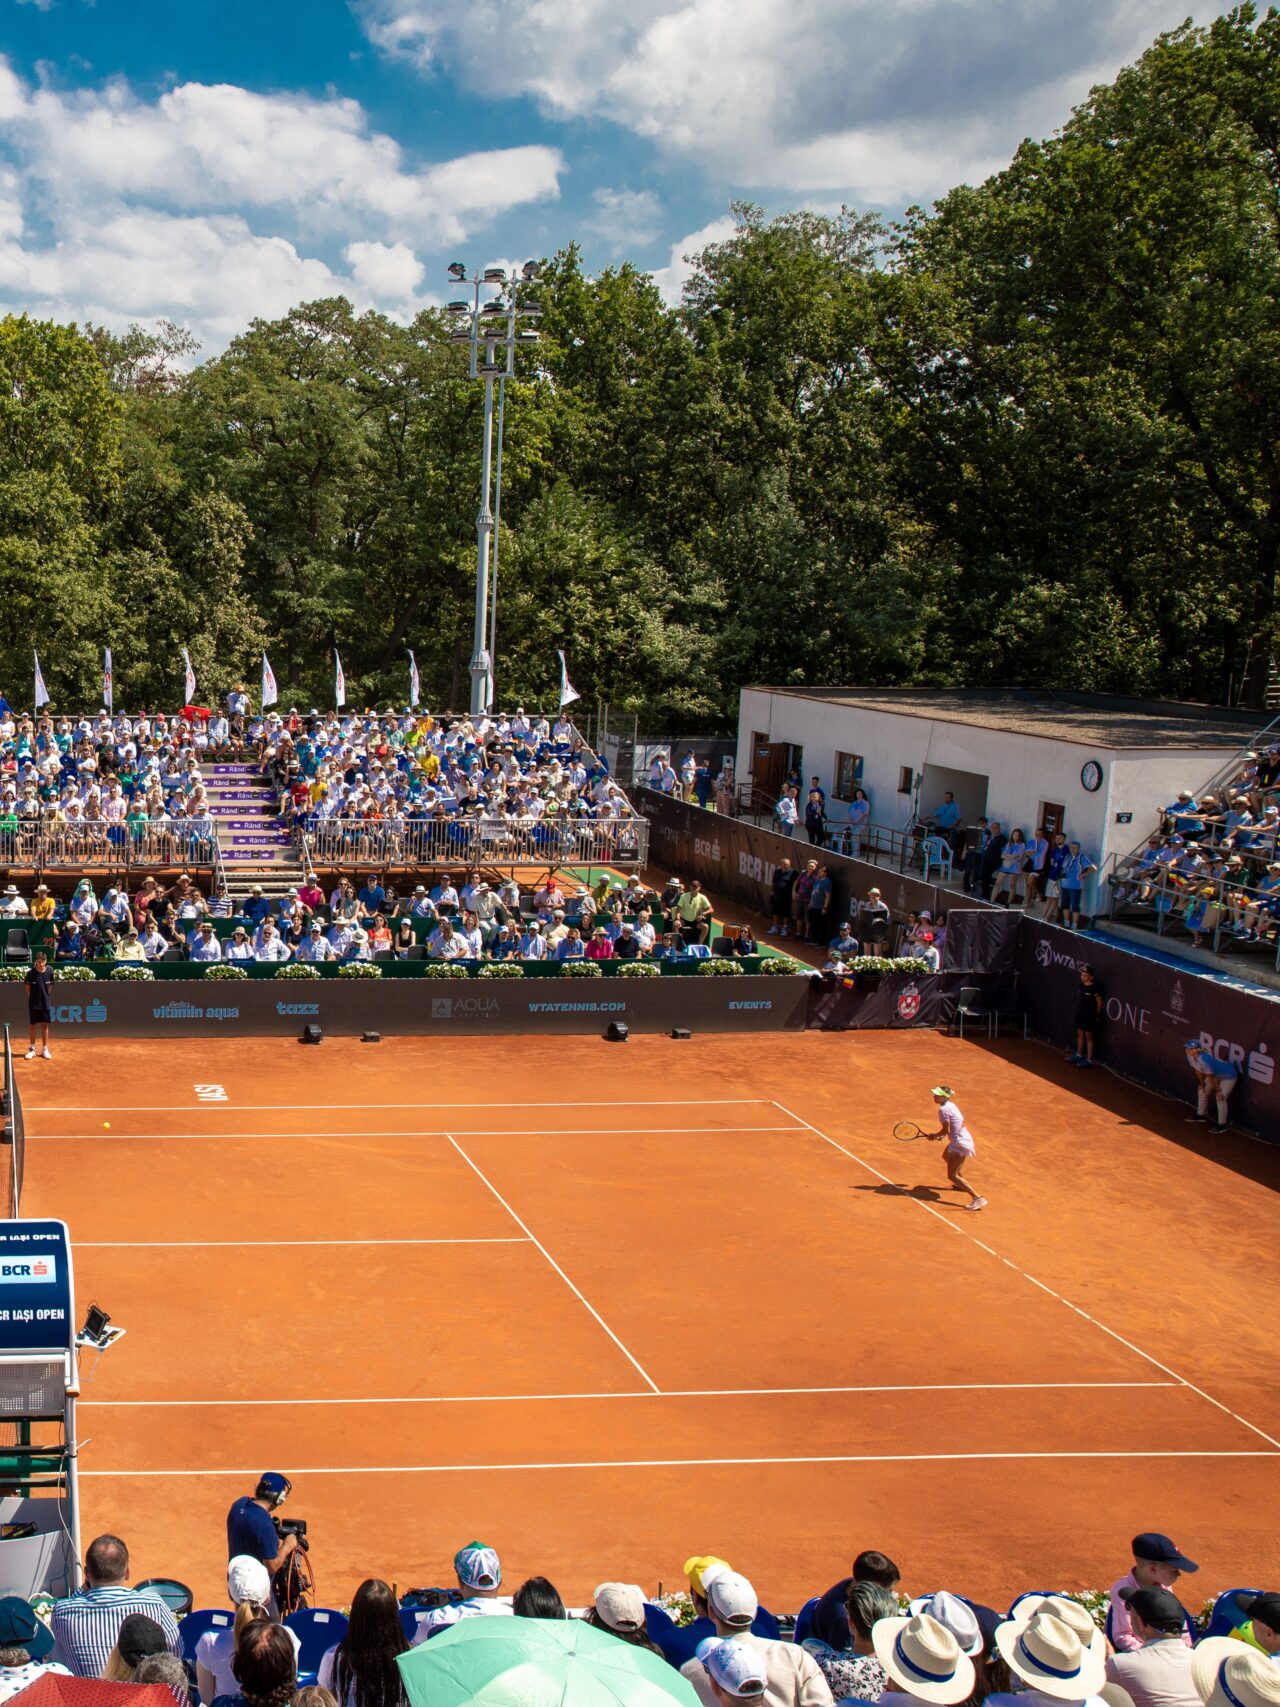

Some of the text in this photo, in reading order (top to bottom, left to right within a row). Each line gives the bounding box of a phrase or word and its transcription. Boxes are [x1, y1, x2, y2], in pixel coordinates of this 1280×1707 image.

[695, 838, 711, 858] BCR
[276, 1001, 319, 1015] tazz
[453, 998, 500, 1011] AQUA
[528, 1002, 626, 1012] WTATENNIS.COM
[729, 1001, 772, 1009] EVENTS
[49, 1005, 82, 1023] BCR
[153, 1006, 239, 1020] vitamin aqua
[1107, 997, 1151, 1034] ONE
[2, 1264, 31, 1276] BCR
[13, 1309, 34, 1323] IAȘI
[37, 1308, 65, 1320] OPEN
